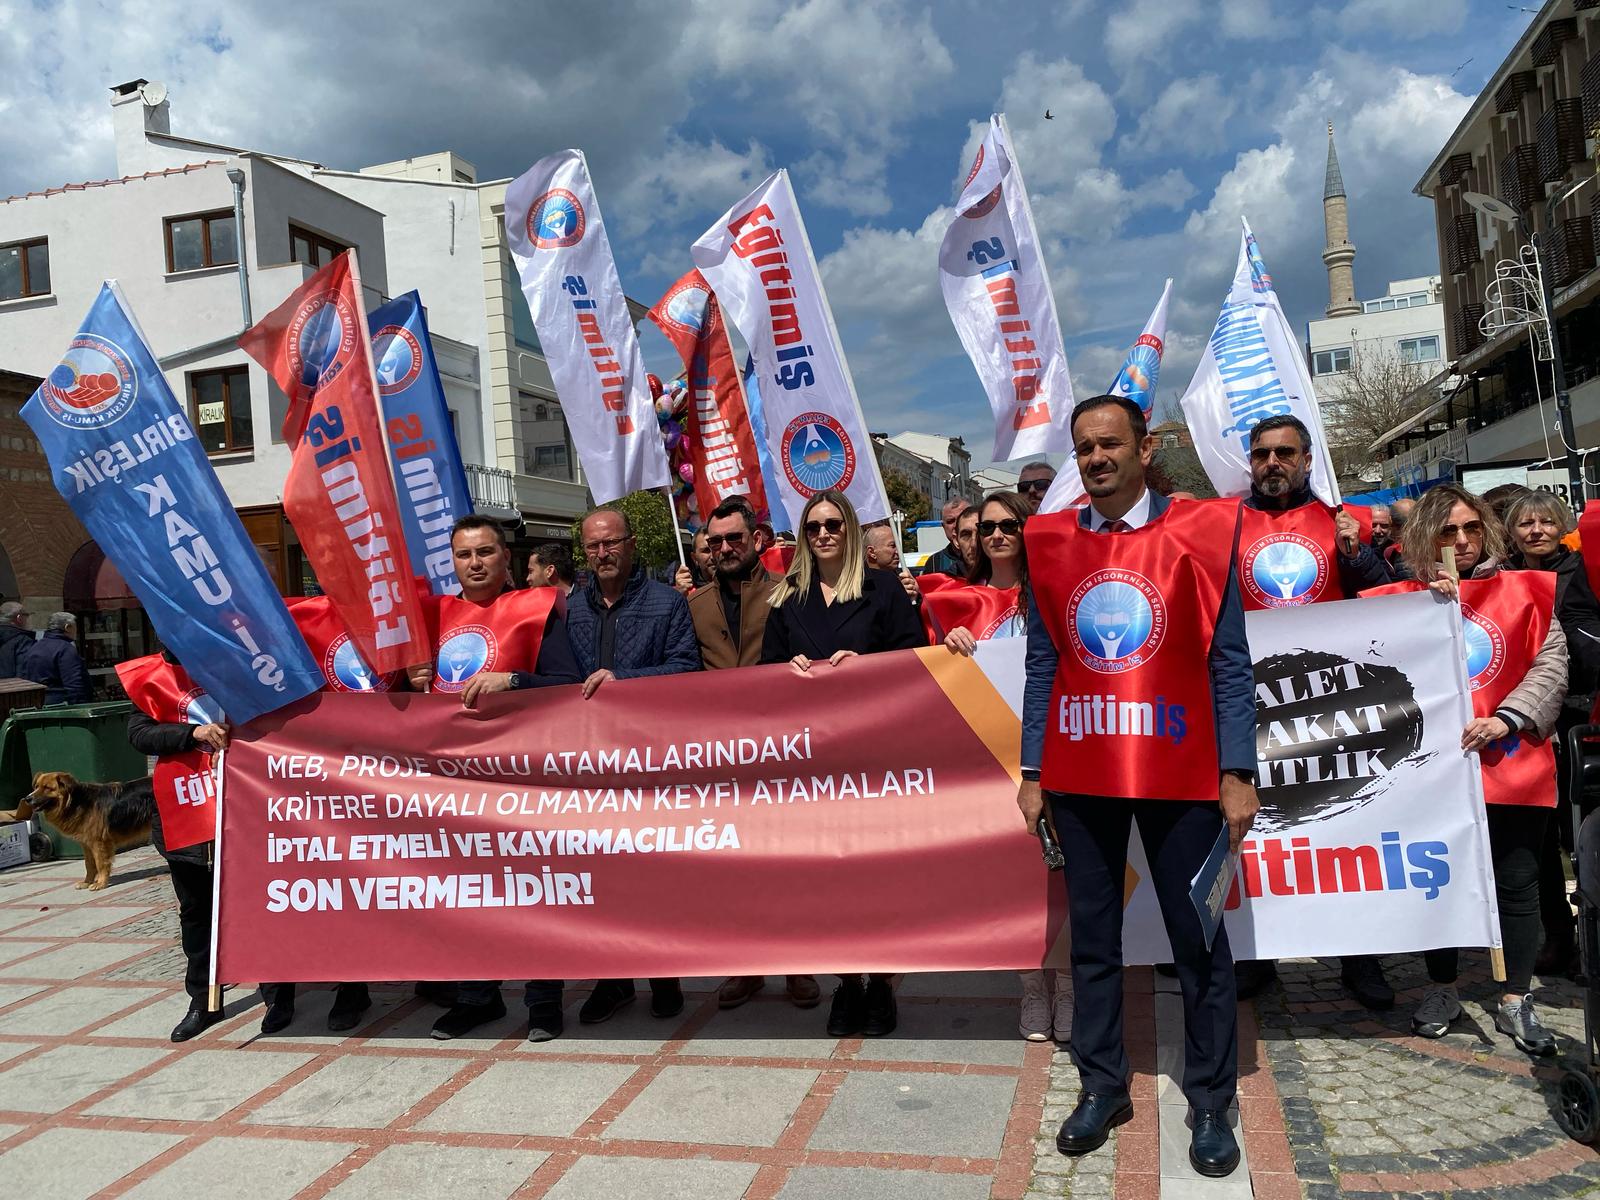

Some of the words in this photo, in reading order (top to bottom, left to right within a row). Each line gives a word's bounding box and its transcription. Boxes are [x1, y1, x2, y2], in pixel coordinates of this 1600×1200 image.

[727, 203, 815, 392] Eğitimiş
[1073, 580, 1093, 602] BİLİM
[1094, 571, 1155, 597] İŞGÖRENLERİ
[1070, 604, 1077, 615] VE
[1147, 597, 1163, 649] SENDİKASI
[1485, 632, 1503, 677] SENDİKASI
[1254, 661, 1368, 711] ALET
[1059, 694, 1188, 745] Eğitimiş
[1256, 703, 1388, 749] AKAT
[267, 754, 329, 781] MEB,
[339, 755, 433, 778] PROJE
[437, 756, 532, 777] OKULU
[542, 727, 813, 776] ATAMALARINDAKİ
[1254, 744, 1389, 789] İTLİK
[267, 791, 378, 822] KRİTERE
[385, 793, 488, 819] DAYALI
[496, 786, 644, 816] OLMAYAN
[653, 777, 742, 812] KEYFİ
[751, 767, 935, 806] ATAMALARI
[267, 832, 343, 863] İPTAL
[348, 828, 451, 861] ETMELİ
[453, 832, 494, 858] VE
[497, 818, 741, 857] KAYIRMACILIĞA
[266, 877, 343, 913] SON
[348, 865, 595, 912] VERMELİDİR!
[1224, 831, 1451, 911] itimiş
